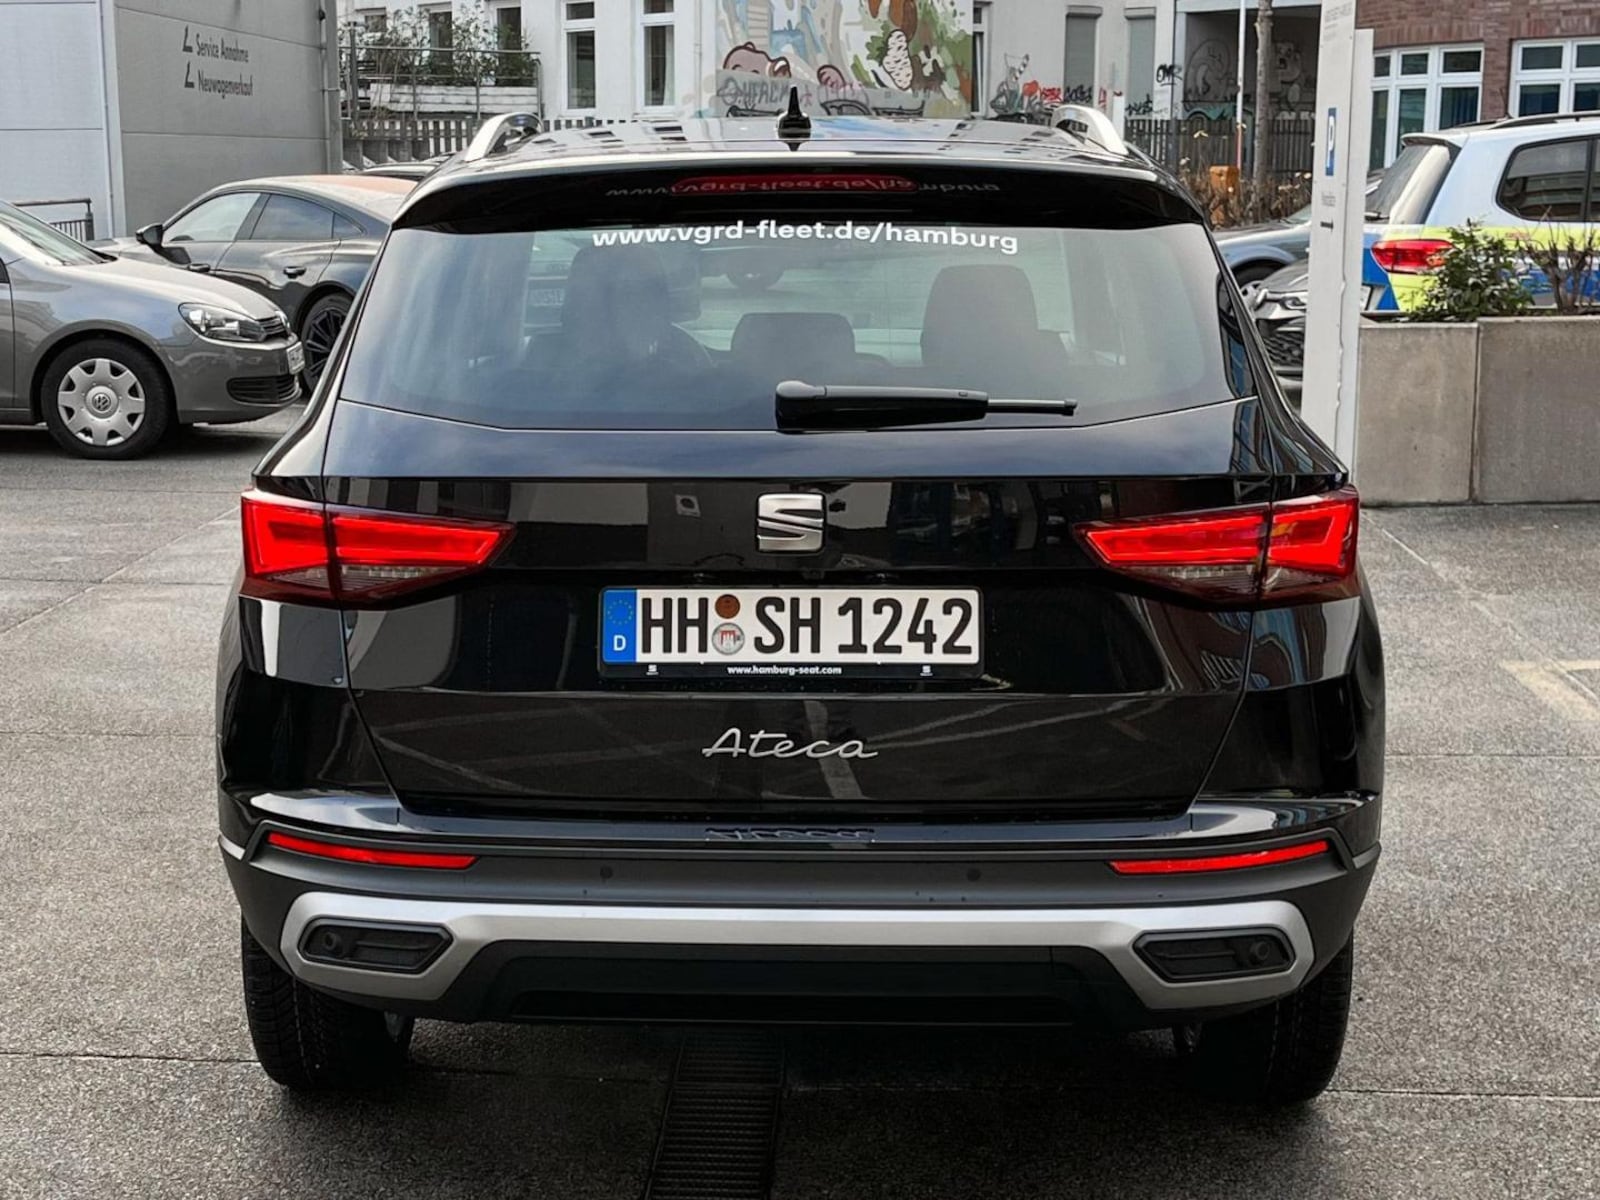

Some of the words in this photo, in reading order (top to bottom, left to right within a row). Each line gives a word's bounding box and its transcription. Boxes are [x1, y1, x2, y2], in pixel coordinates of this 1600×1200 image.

[196, 33, 219, 58] Service
[221, 38, 249, 62] Annahme
[198, 70, 253, 99] Neuwagenverkauf
[592, 220, 1018, 255] www.vgrd-fleet.de/hamburg
[613, 635, 627, 651] D
[642, 598, 709, 653] HH
[754, 597, 821, 654] SH
[838, 597, 972, 654] 1242
[727, 664, 843, 676] www.hamburg-seat.com
[702, 727, 878, 758] Ateca
